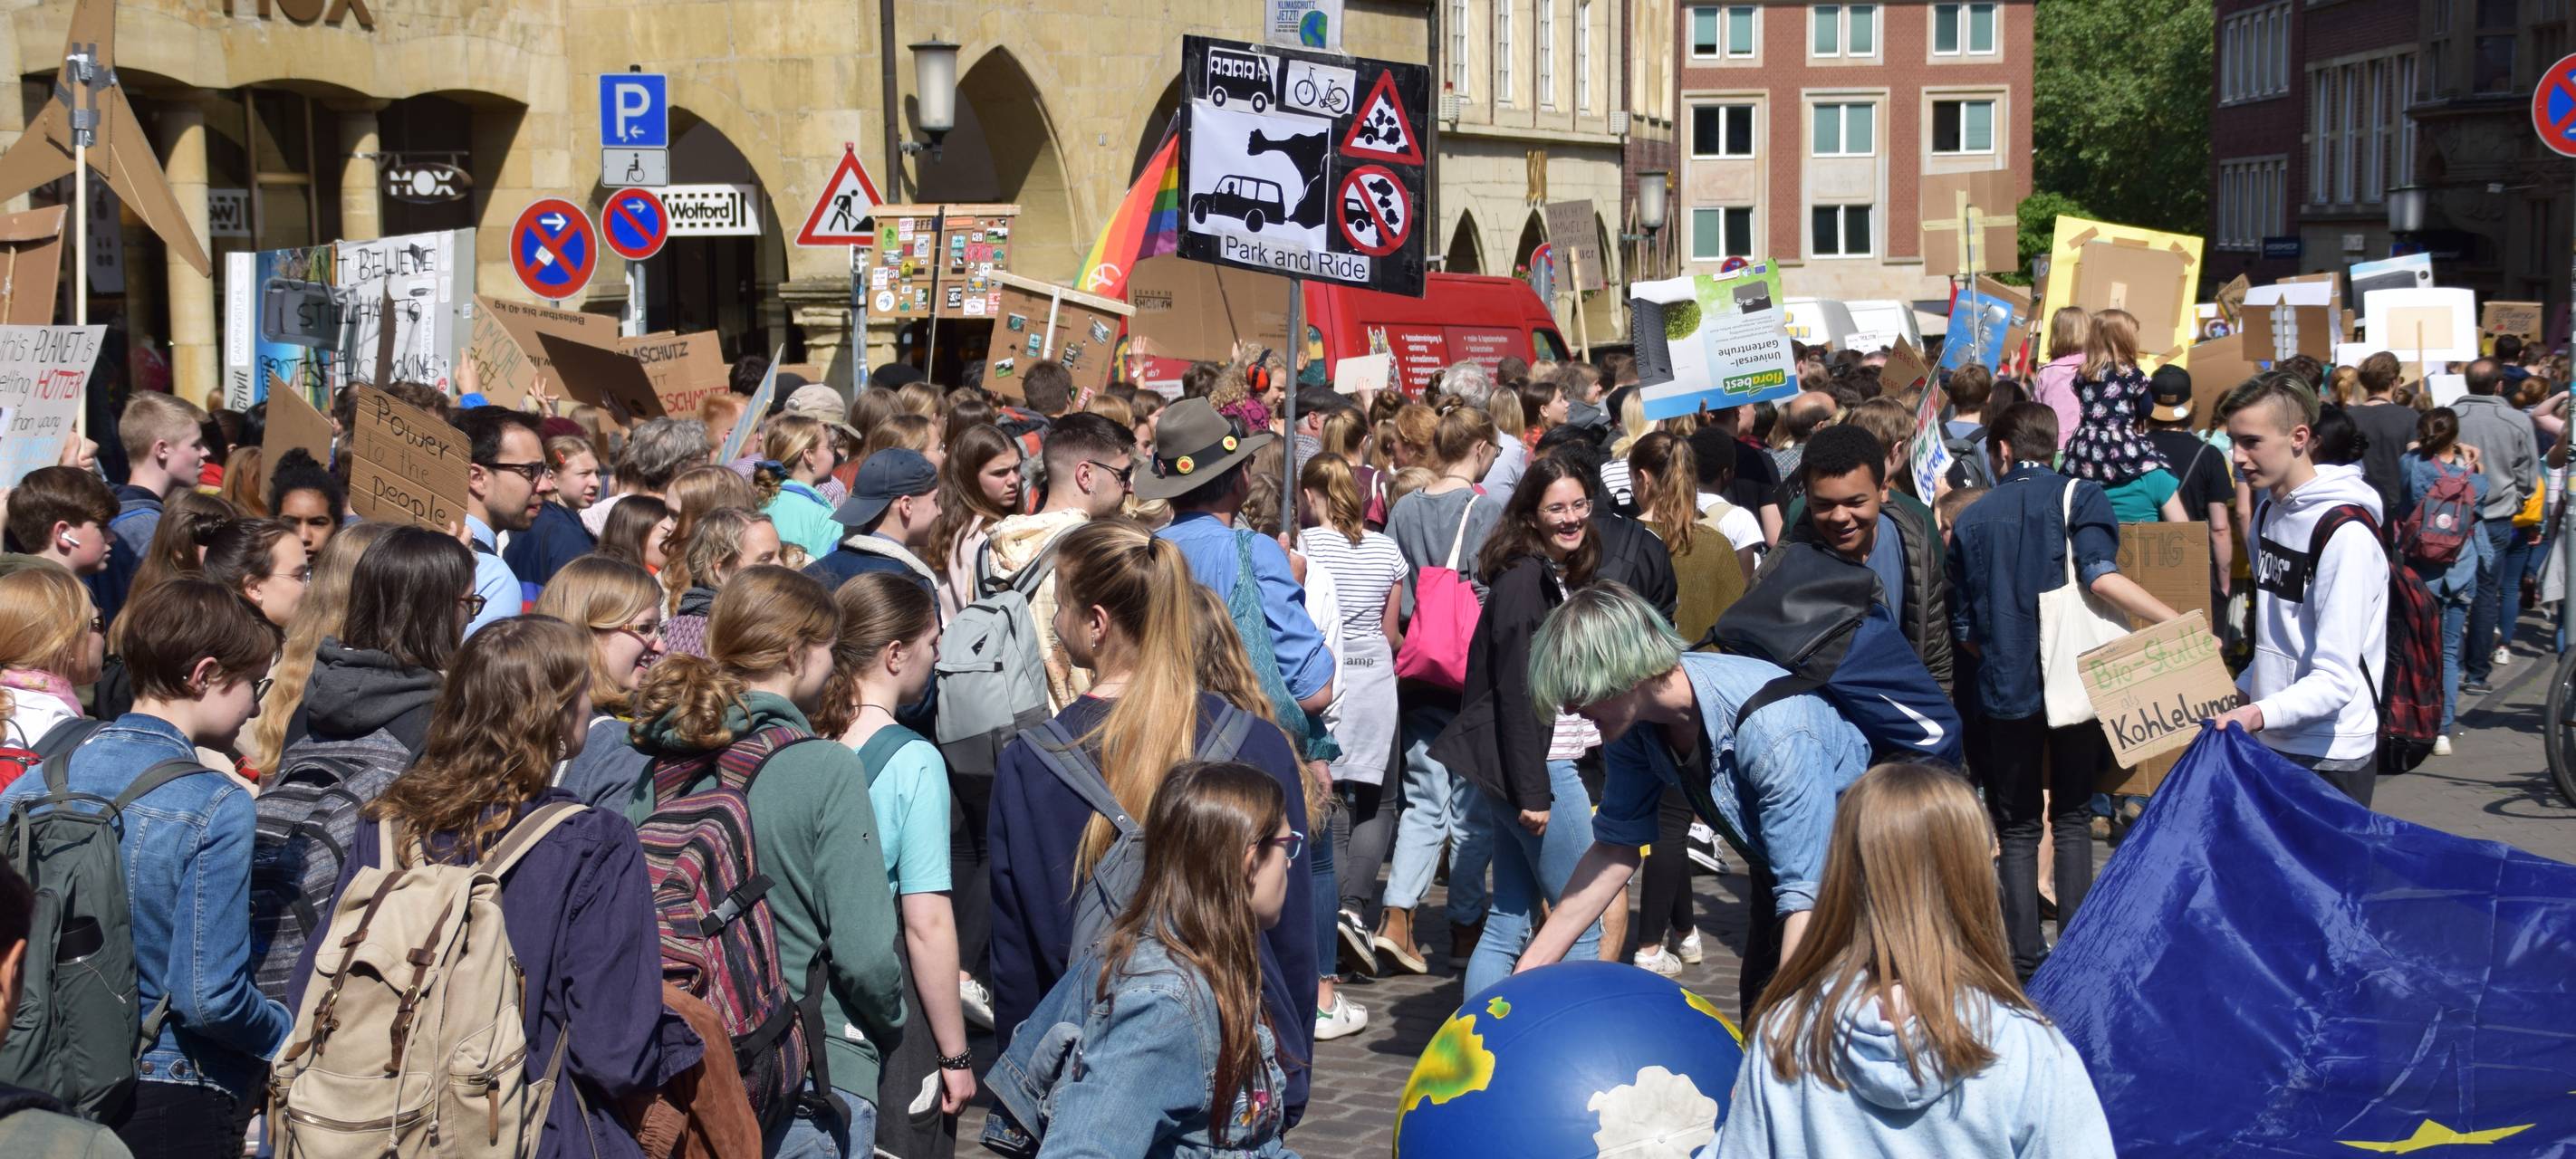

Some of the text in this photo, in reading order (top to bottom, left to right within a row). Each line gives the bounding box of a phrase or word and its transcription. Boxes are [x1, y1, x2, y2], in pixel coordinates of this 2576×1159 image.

[1276, 10, 1299, 21] JETZT!
[615, 83, 651, 138] P
[389, 170, 455, 196] MOX
[668, 201, 730, 219] Wolford
[358, 245, 435, 281] BELIEVE
[1226, 235, 1366, 280] Park and Ride
[494, 300, 585, 327] kg 40 bis Belastbar
[0, 329, 94, 363] this PLANET is
[1718, 340, 1779, 357] Gartentruhe
[1730, 351, 1781, 368] Universal-
[34, 369, 85, 399] HOTTER
[231, 369, 249, 411] crivit
[1725, 371, 1783, 391] florabest
[11, 410, 62, 436] than young
[374, 395, 449, 460] Power
[366, 432, 430, 485] to the
[372, 476, 446, 525] people
[2089, 625, 2215, 690] Bio-Stulle
[2120, 693, 2139, 711] als
